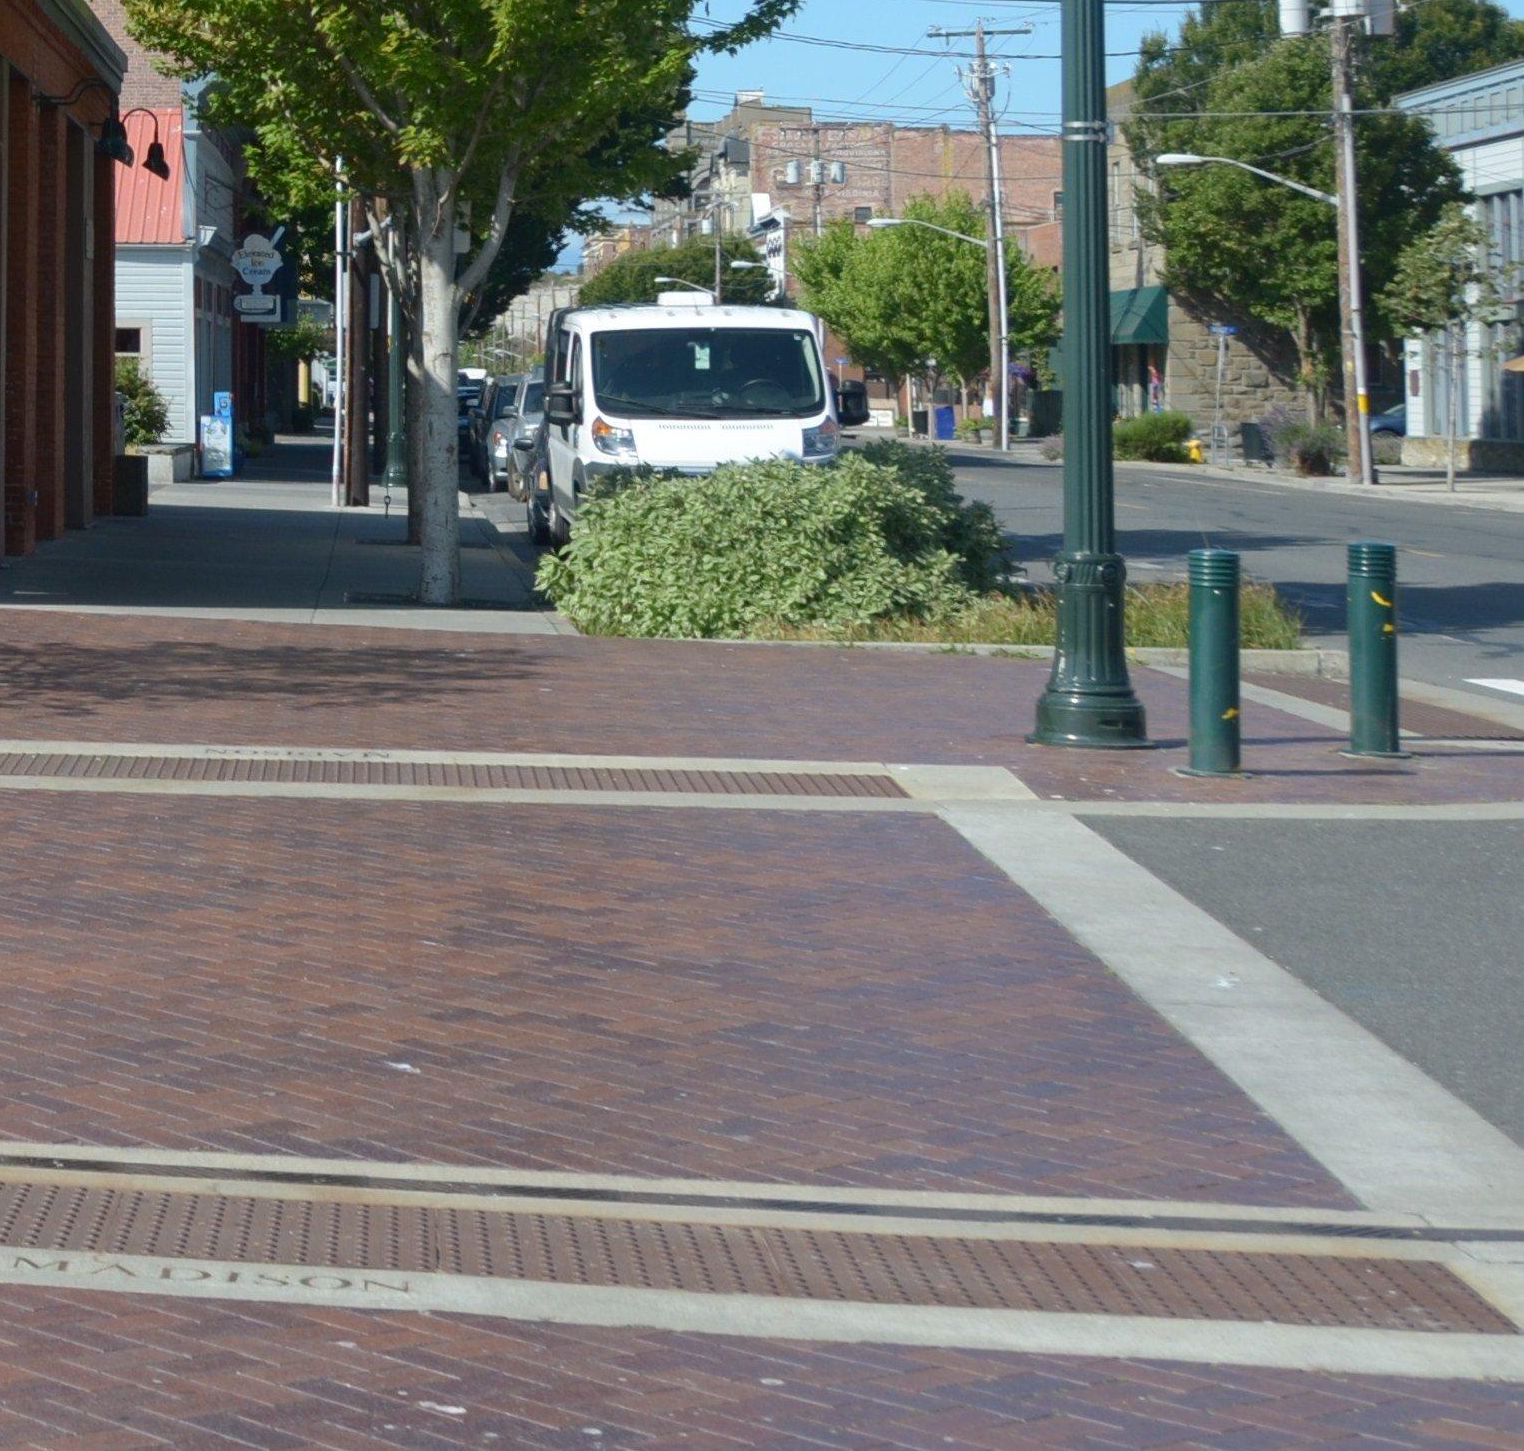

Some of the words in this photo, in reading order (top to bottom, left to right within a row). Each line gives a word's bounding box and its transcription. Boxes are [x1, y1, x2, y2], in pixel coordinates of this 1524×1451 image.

[251, 259, 264, 267] Ice
[242, 267, 271, 275] Cream
[13, 1256, 410, 1294] MADISON
